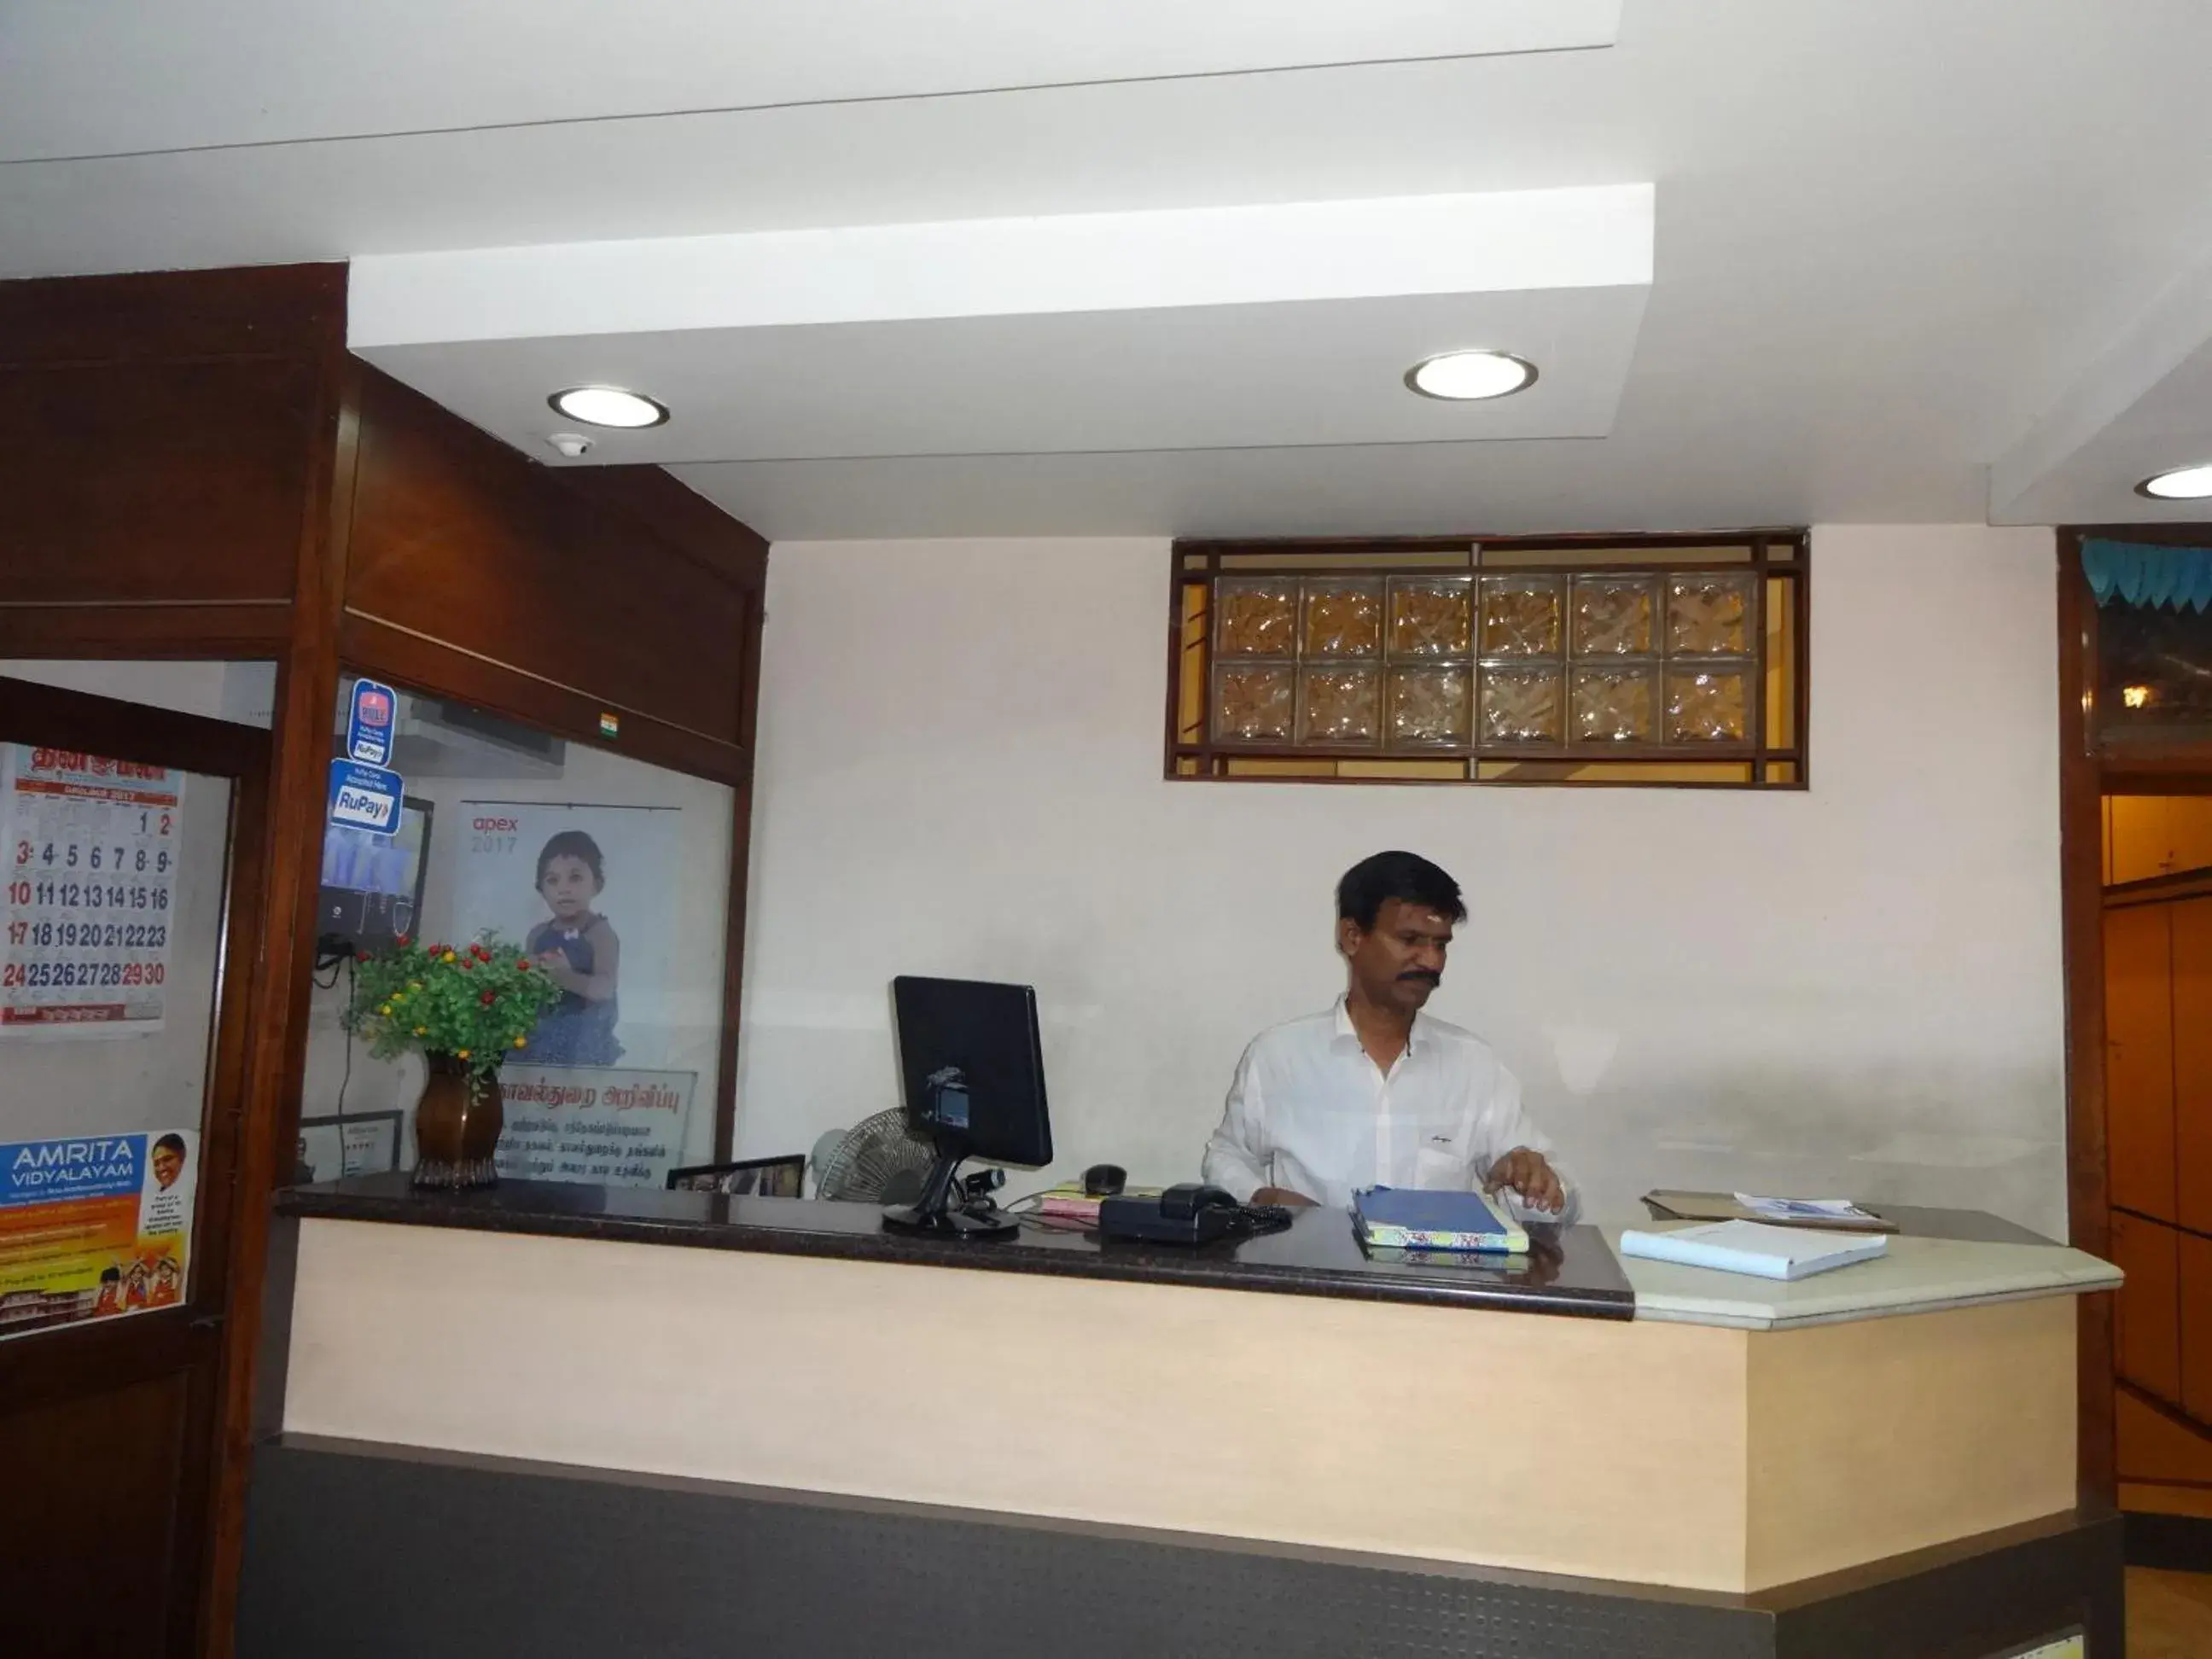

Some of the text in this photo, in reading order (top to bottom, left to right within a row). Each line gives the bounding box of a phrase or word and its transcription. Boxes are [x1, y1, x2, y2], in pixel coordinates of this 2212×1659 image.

[338, 791, 382, 818] RuPay
[139, 812, 172, 835] 1 2
[473, 818, 519, 835] apex
[16, 840, 168, 873] 3 4 5 6 7 8 9
[471, 835, 517, 854] 2017
[9, 881, 168, 911] 10 11 12 13 14 15 16
[8, 921, 166, 947] 17 18 19 20 21 22 23
[3, 961, 165, 987] 24 25 26 27 28 29 30
[13, 1139, 134, 1170] AMRITA
[11, 1162, 134, 1187] VIDYALAYAM
